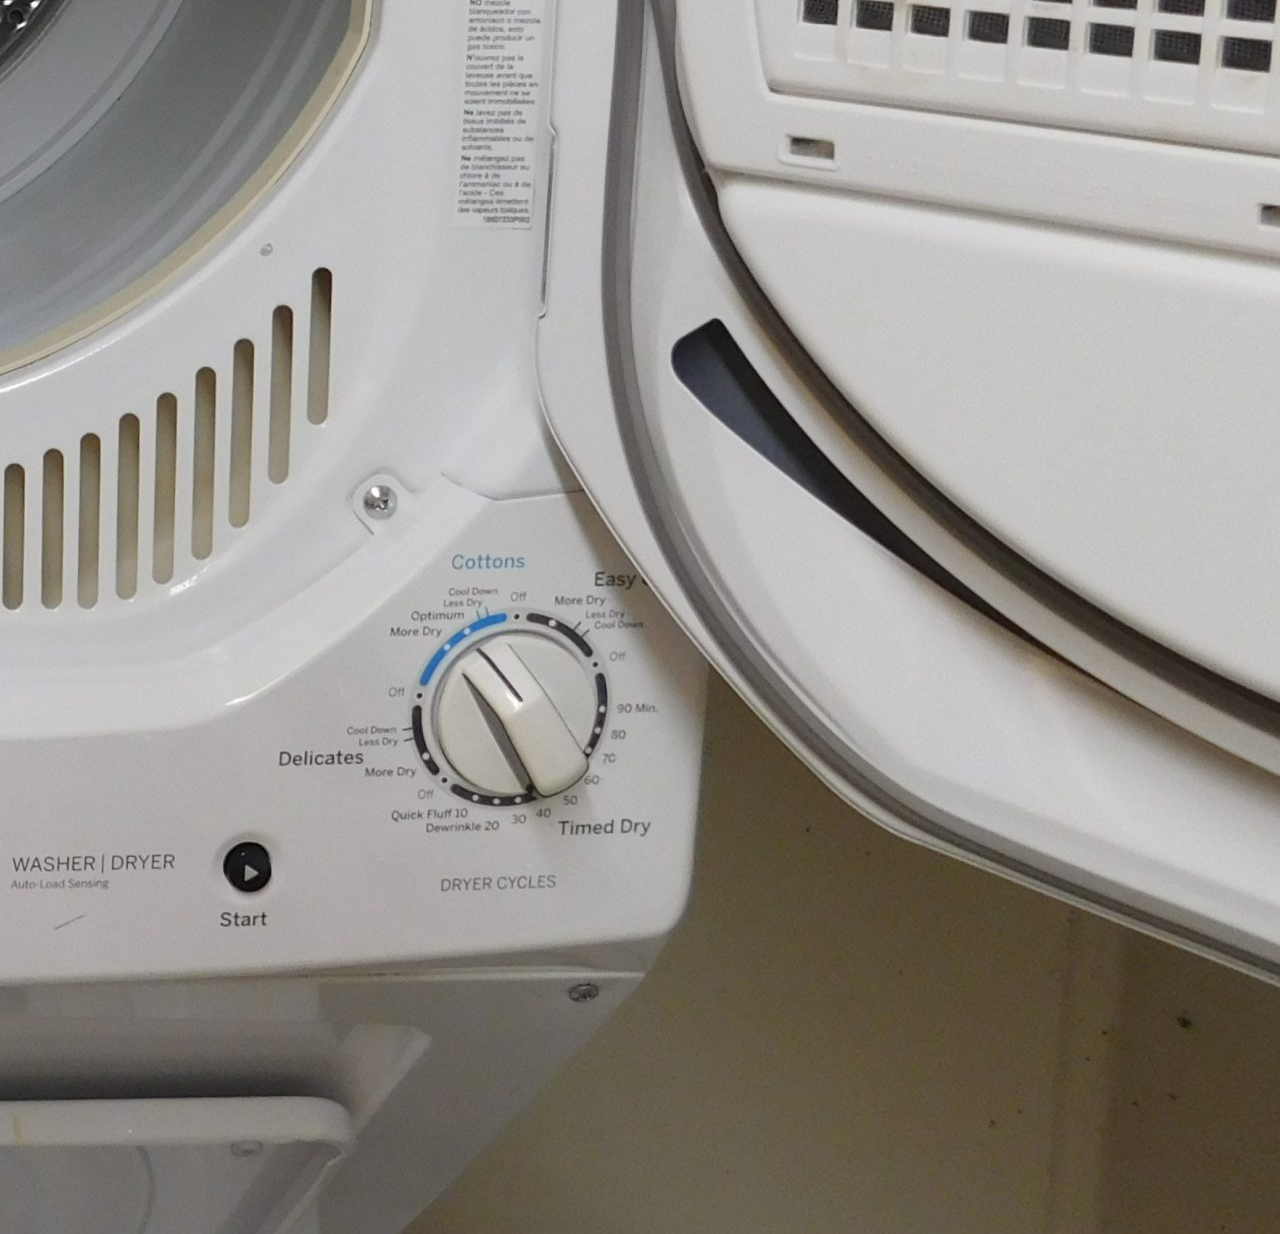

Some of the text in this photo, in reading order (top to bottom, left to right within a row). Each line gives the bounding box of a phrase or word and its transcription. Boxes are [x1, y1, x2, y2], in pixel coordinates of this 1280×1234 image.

[452, 554, 525, 570] Cottons
[595, 571, 637, 590] Easy
[448, 587, 498, 596] Cool Down
[510, 591, 527, 602] Off
[443, 598, 483, 608] Less Dry
[555, 595, 606, 609] More Dry
[411, 611, 464, 622] Optimum
[586, 610, 624, 619] Less Dry
[594, 620, 644, 629] Cool Down
[390, 626, 442, 638] More Dry
[609, 651, 626, 662] Off
[389, 687, 405, 697] Off
[617, 703, 659, 714] 90 Min.
[347, 726, 397, 735] Cool Down
[611, 730, 626, 740] 80
[359, 737, 399, 747] Less Dry
[279, 750, 364, 766] Delicates
[603, 753, 616, 764] 70
[365, 767, 416, 778] More Dry
[584, 775, 600, 785] 60
[417, 789, 434, 800] Off
[562, 795, 578, 806] 50
[391, 808, 468, 822] Quick Fluff 10
[536, 808, 551, 818] 40
[512, 814, 526, 824] 30
[426, 821, 499, 833] Dewrinkle 20
[558, 819, 651, 837] Timed Dry
[13, 854, 175, 872] WASHER DRYER
[11, 878, 109, 890] Auto-Load Sensing
[441, 875, 556, 892] DRYER CYCLES
[220, 912, 267, 927] Start
